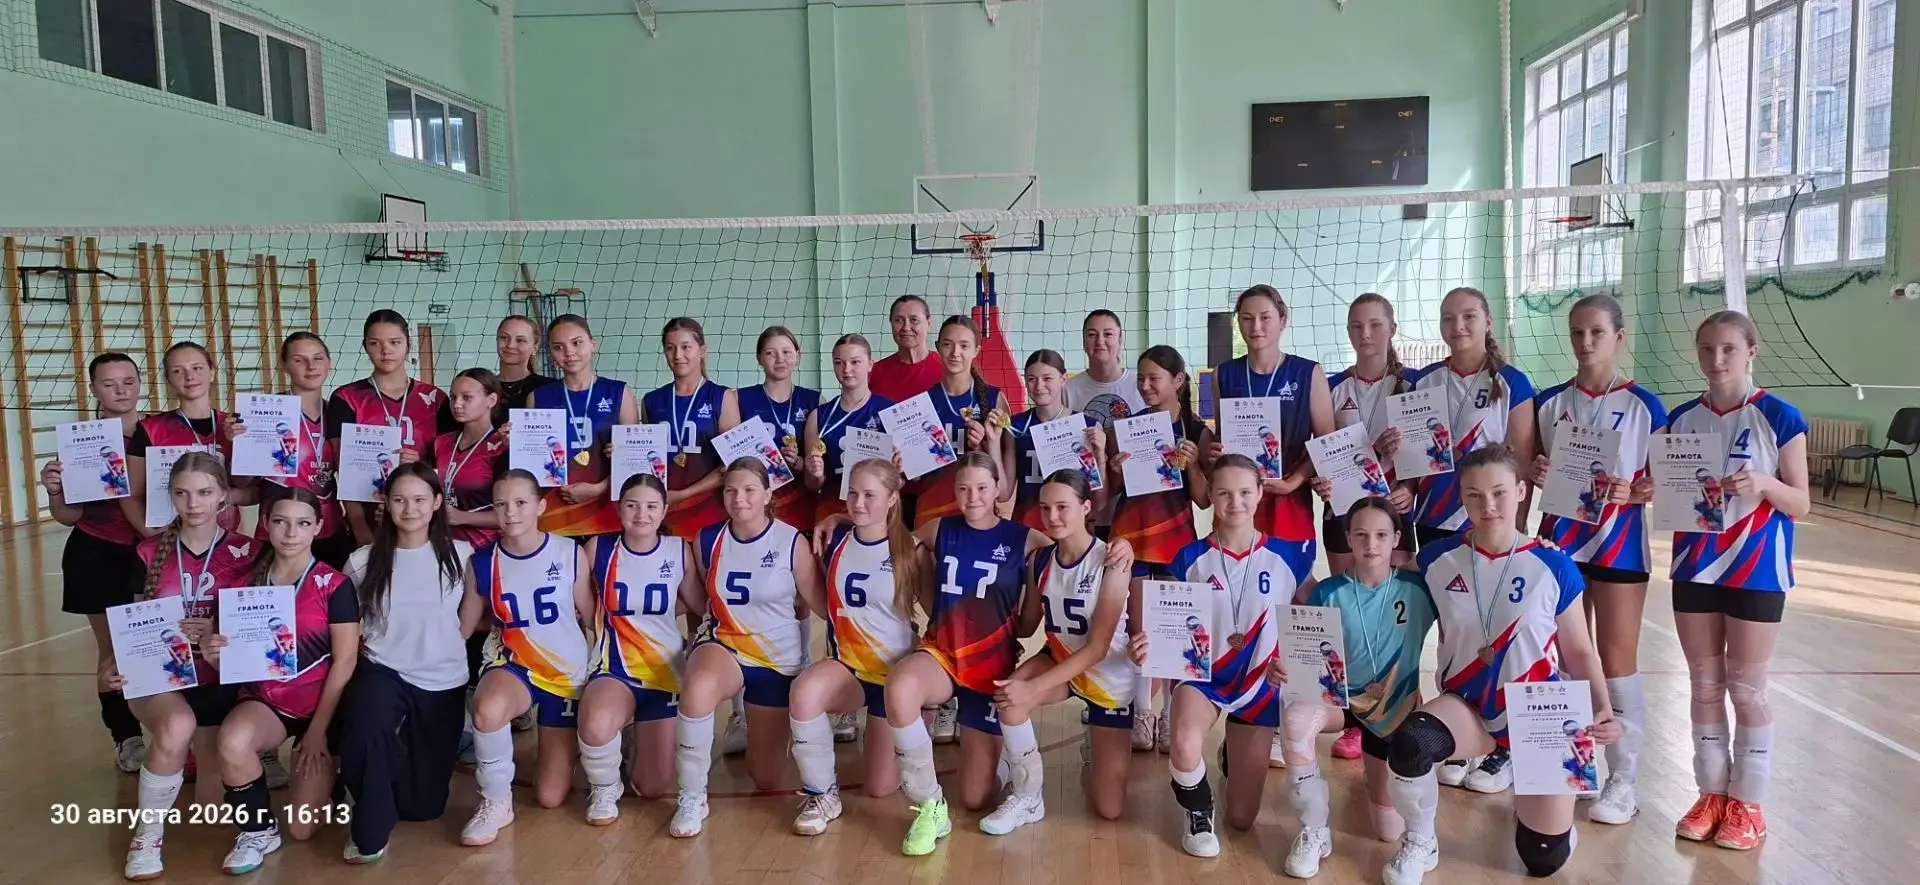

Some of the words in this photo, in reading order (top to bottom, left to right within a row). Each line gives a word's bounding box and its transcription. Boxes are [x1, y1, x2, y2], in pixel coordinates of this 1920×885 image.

[1398, 110, 1414, 118] СЧЕТ
[1474, 388, 1489, 409] 5
[1401, 405, 1431, 416] ГРАМОТА
[897, 412, 922, 424] ГРАМОТА
[1611, 411, 1625, 430] 7
[72, 434, 105, 444] ГРАМОТА
[1046, 431, 1073, 442] ГРАМОТА
[1130, 428, 1157, 438] ГРАМОТА
[1735, 428, 1751, 451] 4
[355, 439, 385, 447] ГРАМОТА
[730, 434, 755, 450] ГРАМОТА
[856, 443, 880, 452] ГРАМОТА
[1569, 441, 1601, 452] ГРАМОТА
[1325, 443, 1355, 457] ГРАМОТА
[941, 555, 999, 599] 17
[1257, 570, 1271, 595] 6
[182, 572, 215, 601] 12
[726, 571, 752, 606] 5
[844, 572, 871, 608] 6
[1507, 576, 1526, 604] 3
[612, 582, 670, 616] 10
[1159, 600, 1193, 608] ГРАМОТА
[237, 603, 275, 612] ГРАМОТА
[500, 585, 559, 629] 16
[1393, 600, 1407, 625] 2
[128, 616, 165, 629] ГРАМОТА
[1040, 595, 1089, 636] 15
[1292, 625, 1325, 633] ГРАМОТА
[1527, 703, 1569, 711] ГРАМОТА
